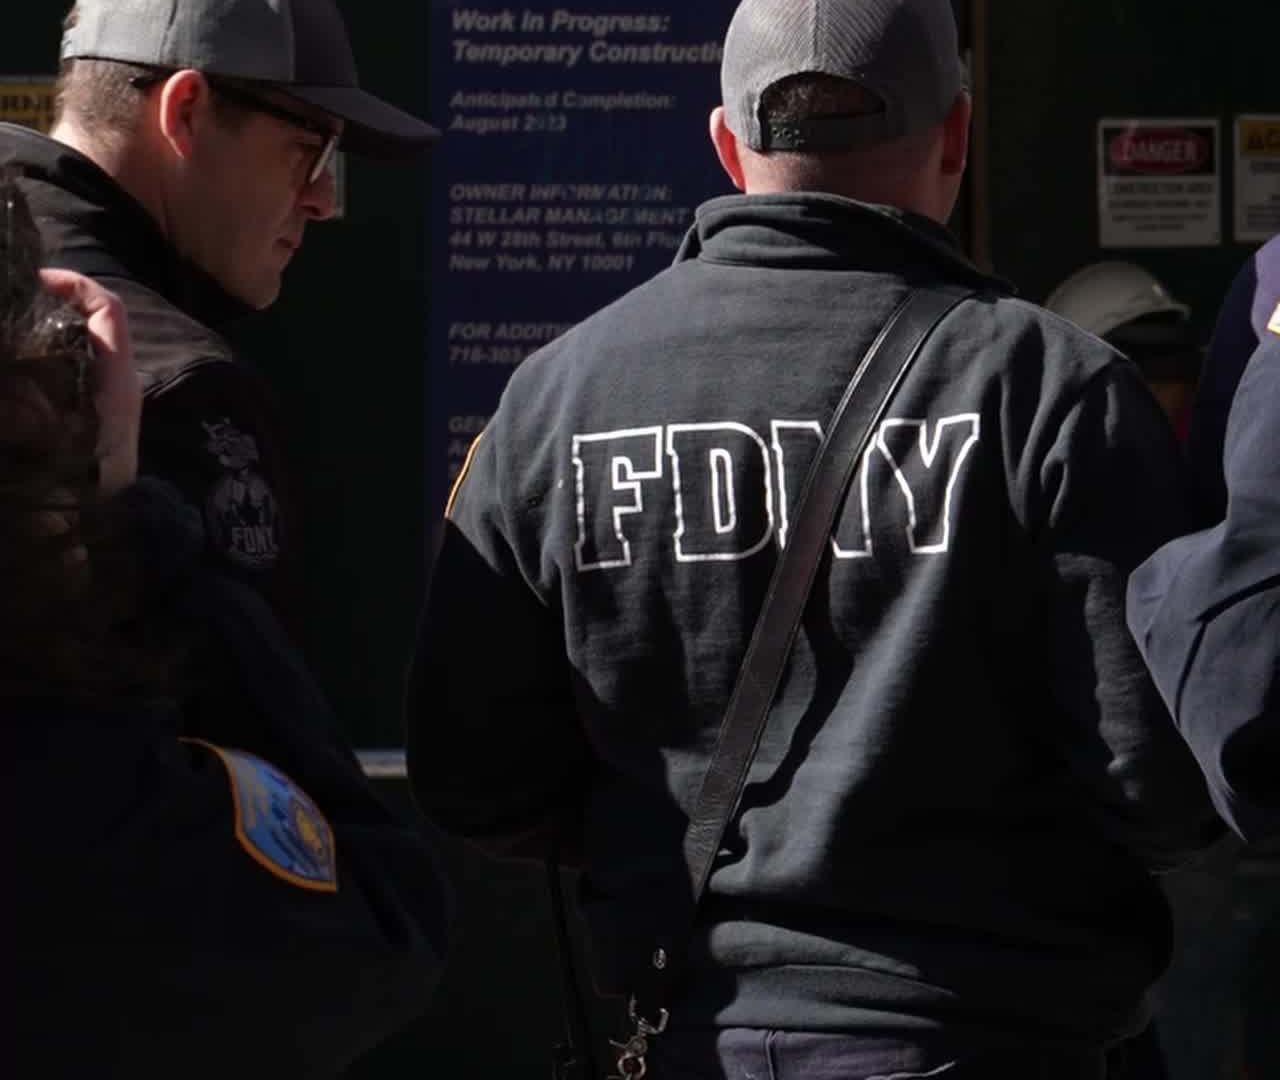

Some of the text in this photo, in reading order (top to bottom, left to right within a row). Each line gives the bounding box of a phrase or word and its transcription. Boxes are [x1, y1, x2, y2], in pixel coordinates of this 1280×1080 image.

[451, 8, 514, 32] Work
[549, 8, 672, 39] Progress:
[452, 38, 583, 70] Temporary
[562, 88, 677, 113] Completion:
[447, 114, 520, 137] August
[448, 183, 526, 201] OWNER
[448, 207, 541, 225] STELLAR
[476, 230, 497, 248] W
[545, 230, 607, 250] Street,
[448, 254, 492, 272] New
[496, 254, 543, 273] York,
[546, 254, 580, 272] NY
[448, 322, 489, 340] FOR
